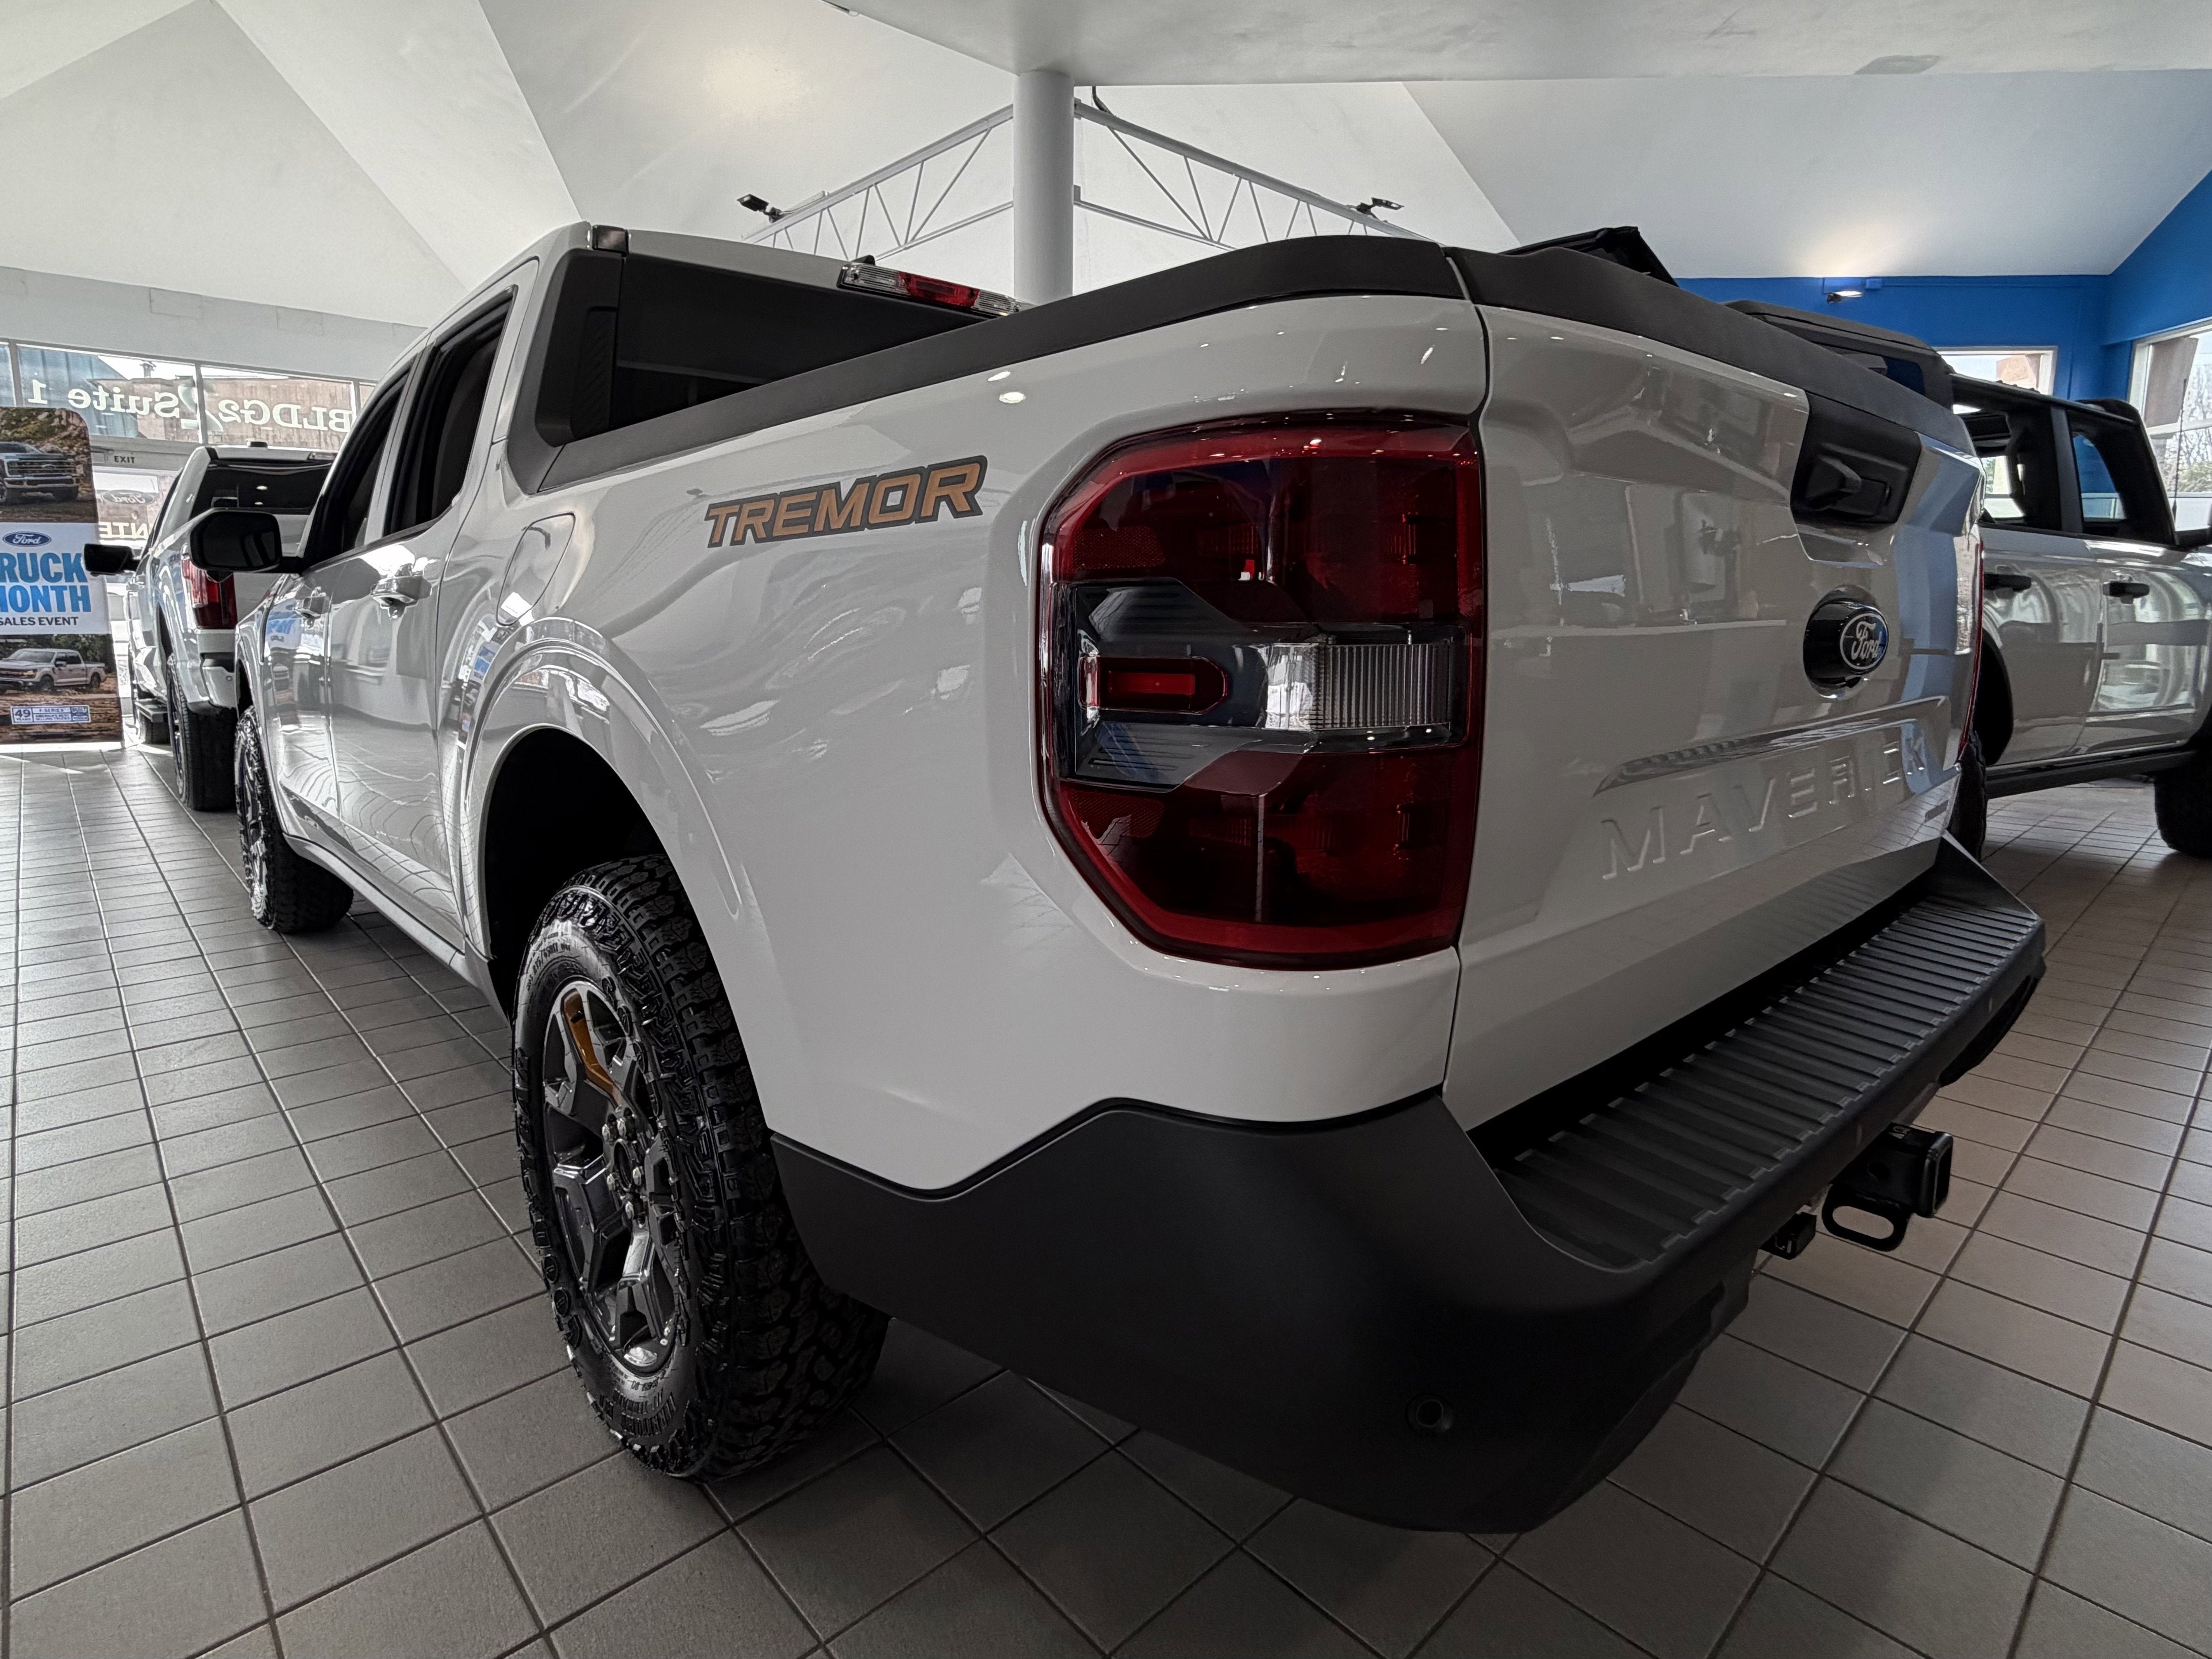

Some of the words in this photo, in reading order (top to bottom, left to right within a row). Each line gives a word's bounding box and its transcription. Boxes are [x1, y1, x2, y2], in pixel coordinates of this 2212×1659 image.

[114, 456, 135, 464] EXIT
[705, 455, 988, 548] TREMOR
[0, 552, 88, 583] RUCK
[0, 584, 91, 612] ONTH
[38, 616, 79, 625] EVENT
[15, 709, 31, 718] 49
